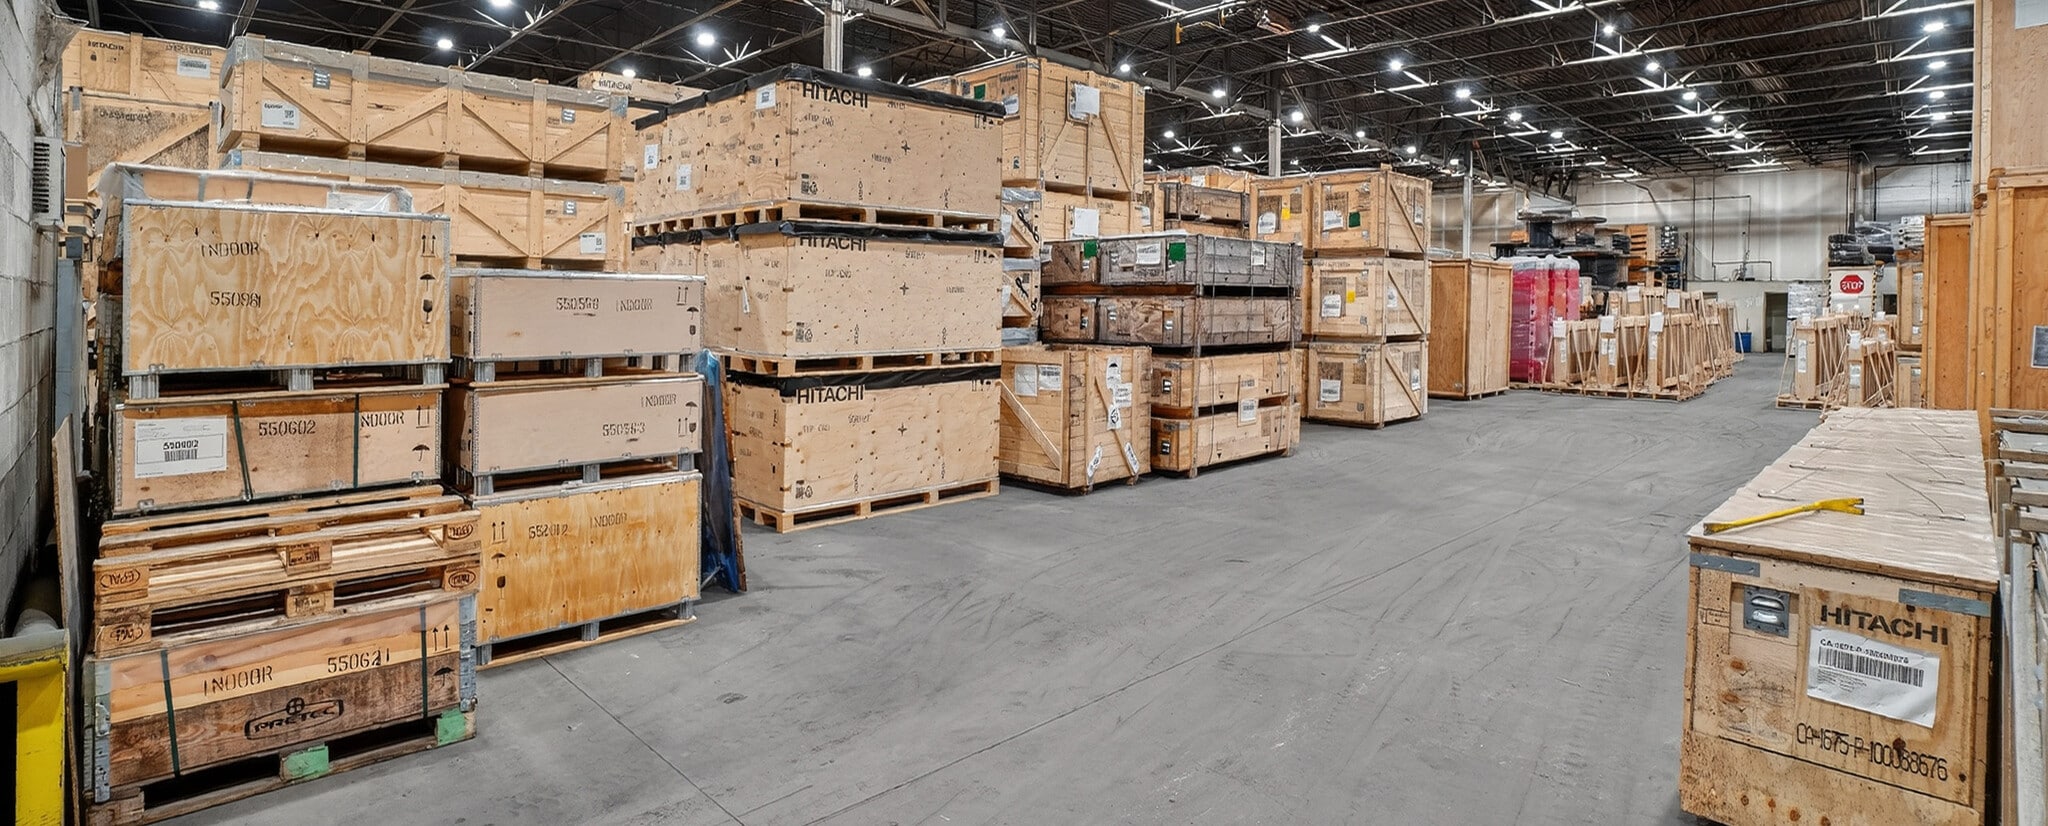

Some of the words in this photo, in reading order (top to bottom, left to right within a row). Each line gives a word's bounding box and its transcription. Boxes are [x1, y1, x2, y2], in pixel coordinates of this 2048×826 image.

[802, 82, 868, 108] HITACHI
[201, 242, 260, 258] INDOOR
[800, 236, 867, 252] HITACHI
[797, 384, 864, 405] HITACHI
[259, 419, 317, 437] 550602
[360, 411, 405, 428] NDOOR
[1820, 604, 1949, 646] HITACHI
[203, 664, 274, 697] INDOOR
